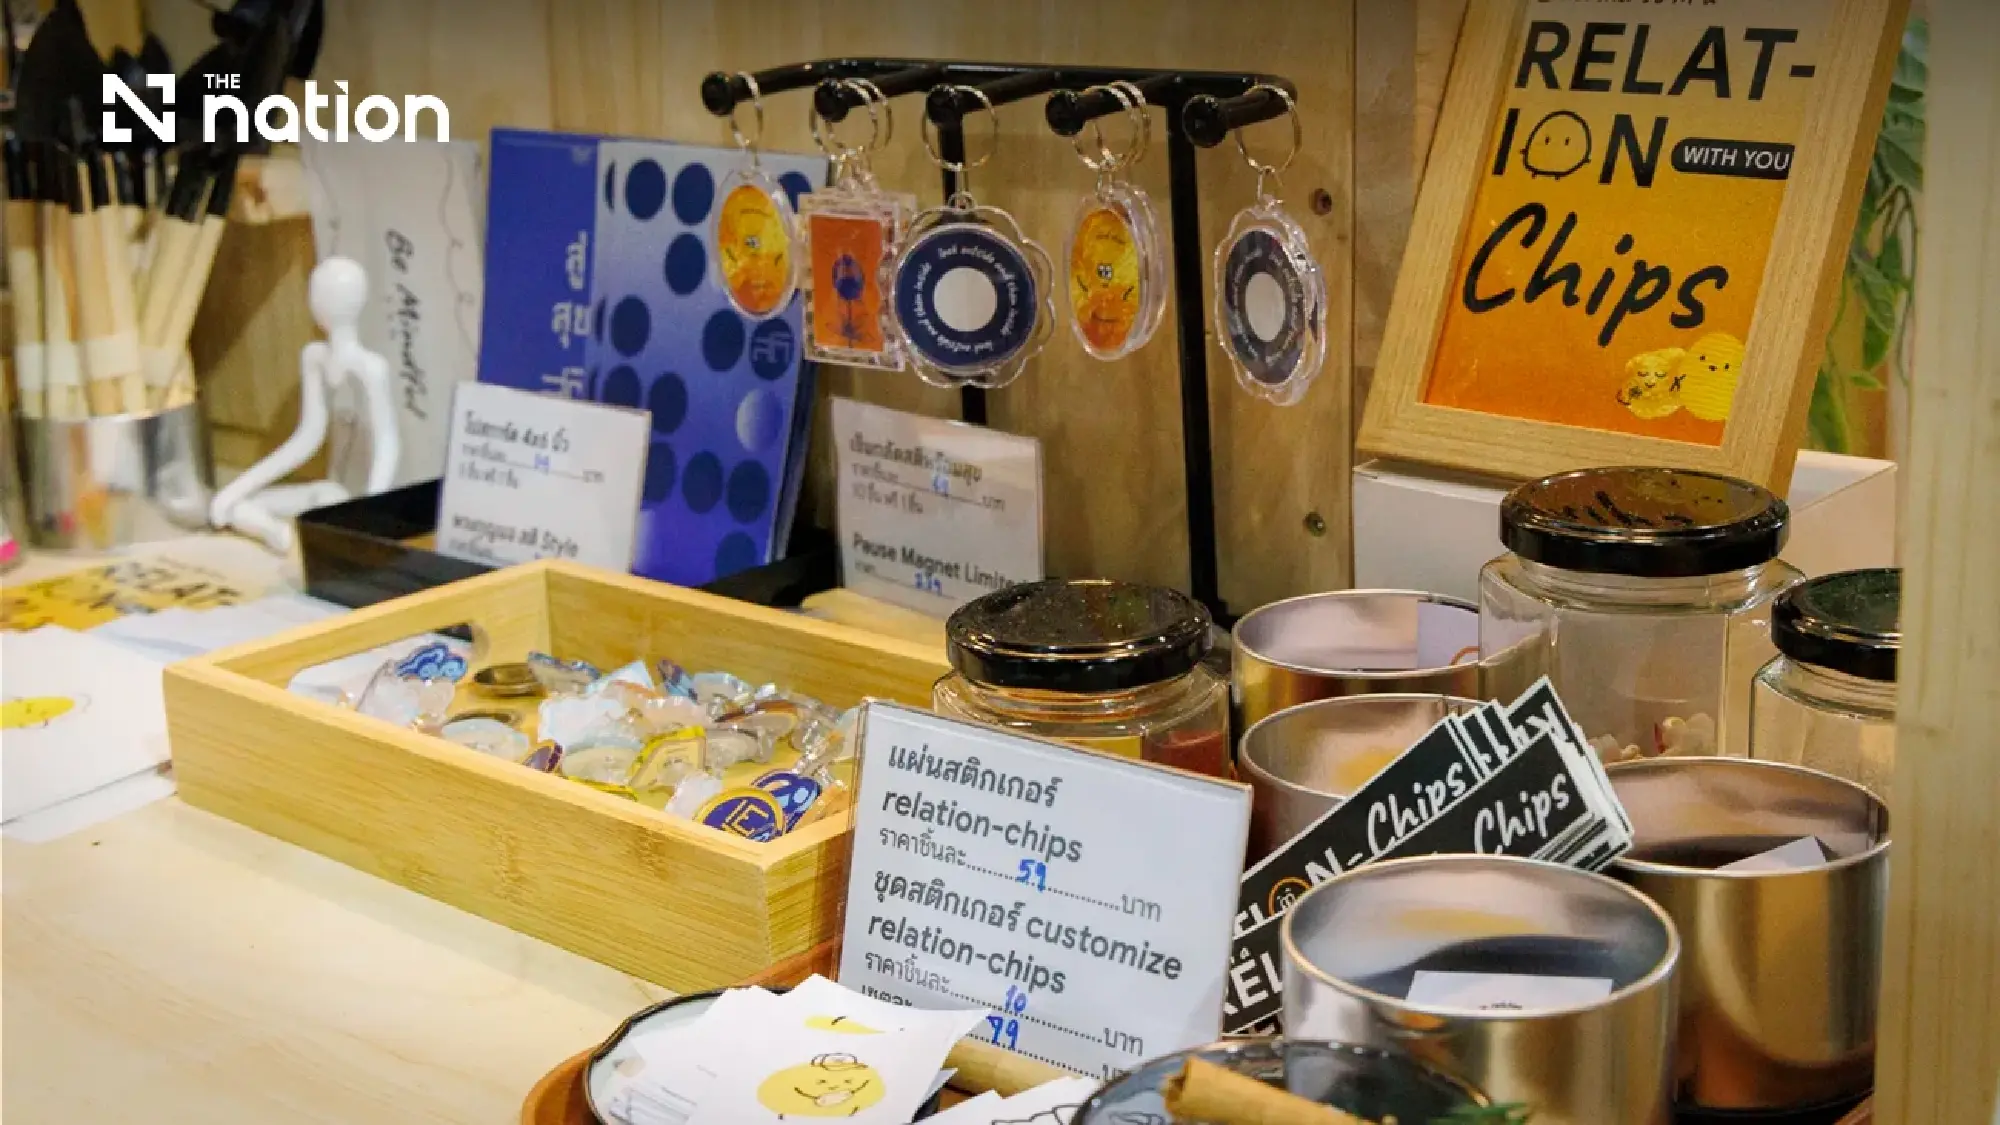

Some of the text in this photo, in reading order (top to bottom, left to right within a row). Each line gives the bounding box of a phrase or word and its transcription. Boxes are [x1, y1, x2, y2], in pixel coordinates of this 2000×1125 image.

[1514, 20, 1816, 101] RELAT-
[1683, 144, 1738, 168] WITH
[1744, 149, 1790, 172] YOU
[1462, 201, 1729, 348] Chips
[853, 530, 898, 563] Pause
[900, 545, 961, 580] Magnet
[887, 742, 1063, 808] แผ่นสติกเกอร์
[882, 790, 1084, 864] relation-chips
[867, 913, 1067, 995] relation-chips
[873, 869, 1184, 981] ชุดสติกเกอร์ customize
